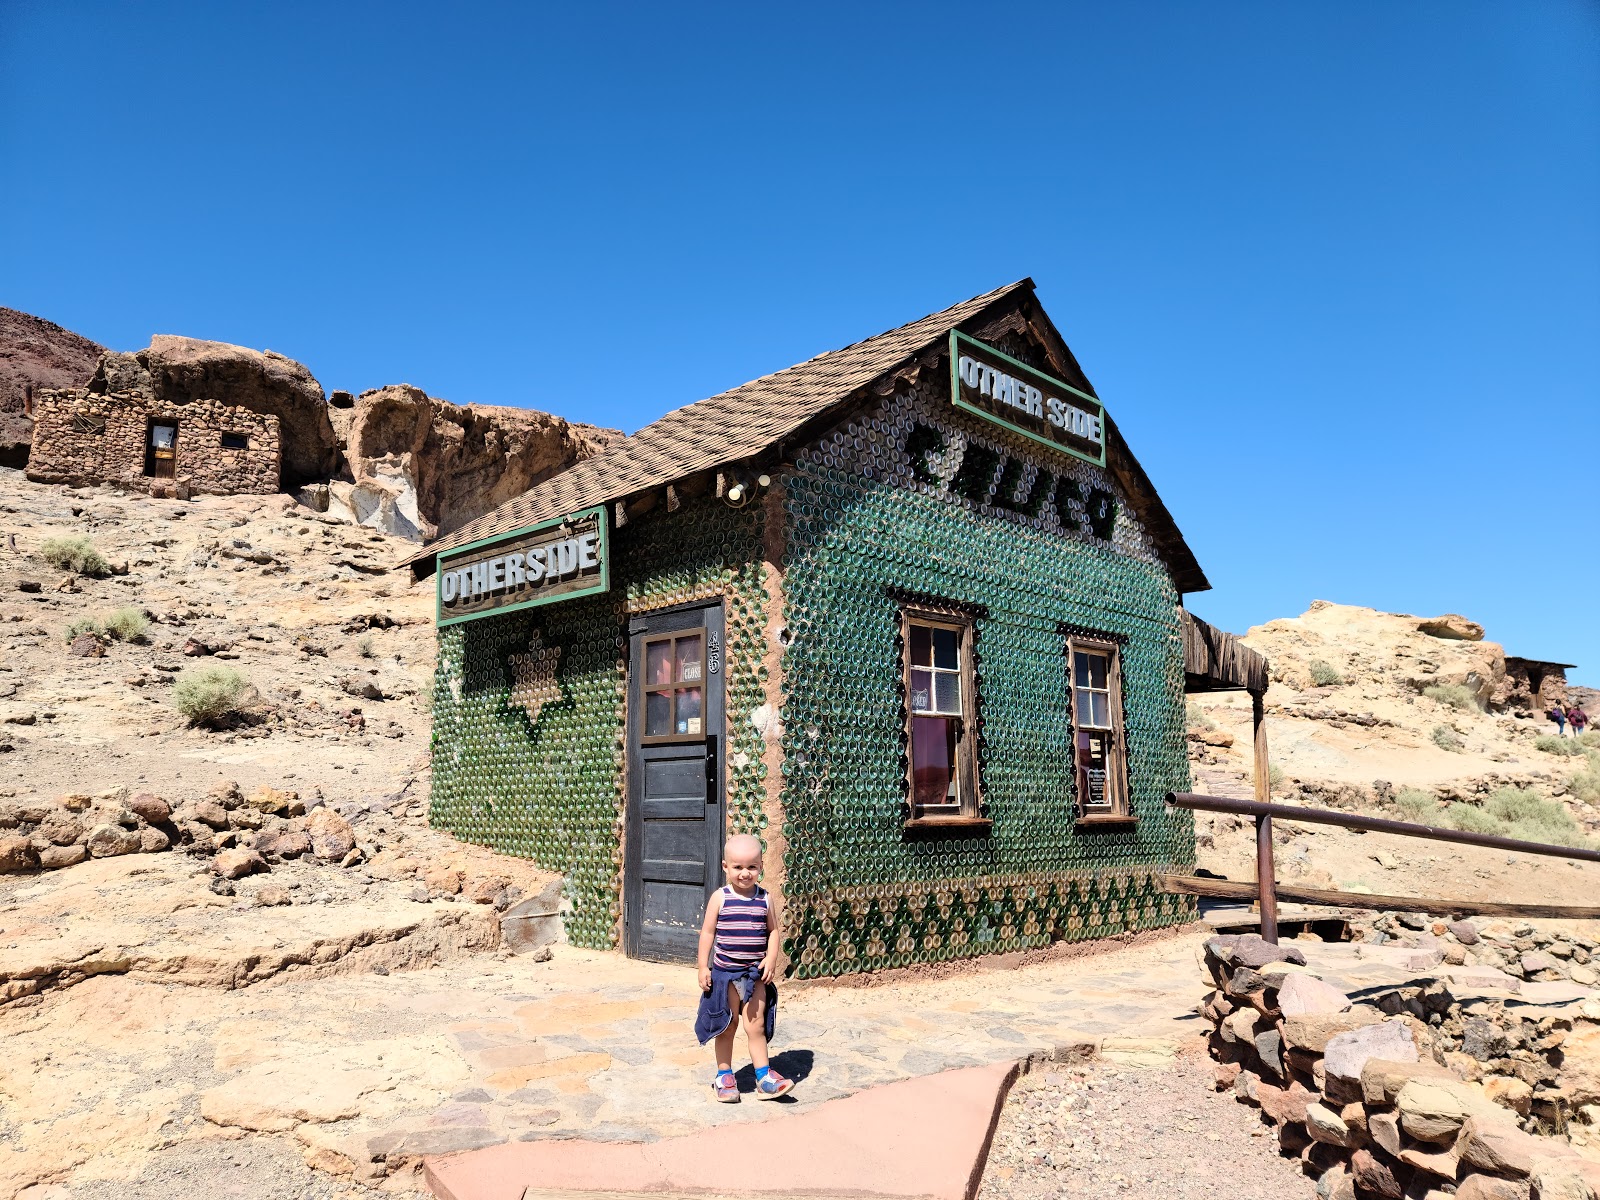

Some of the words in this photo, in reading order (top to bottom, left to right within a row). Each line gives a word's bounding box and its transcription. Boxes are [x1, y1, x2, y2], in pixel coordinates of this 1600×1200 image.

[959, 355, 1043, 419] OTHER
[1047, 397, 1102, 445] SIDE
[441, 533, 599, 602] OTHERSIDE
[684, 667, 701, 680] CLOSE
